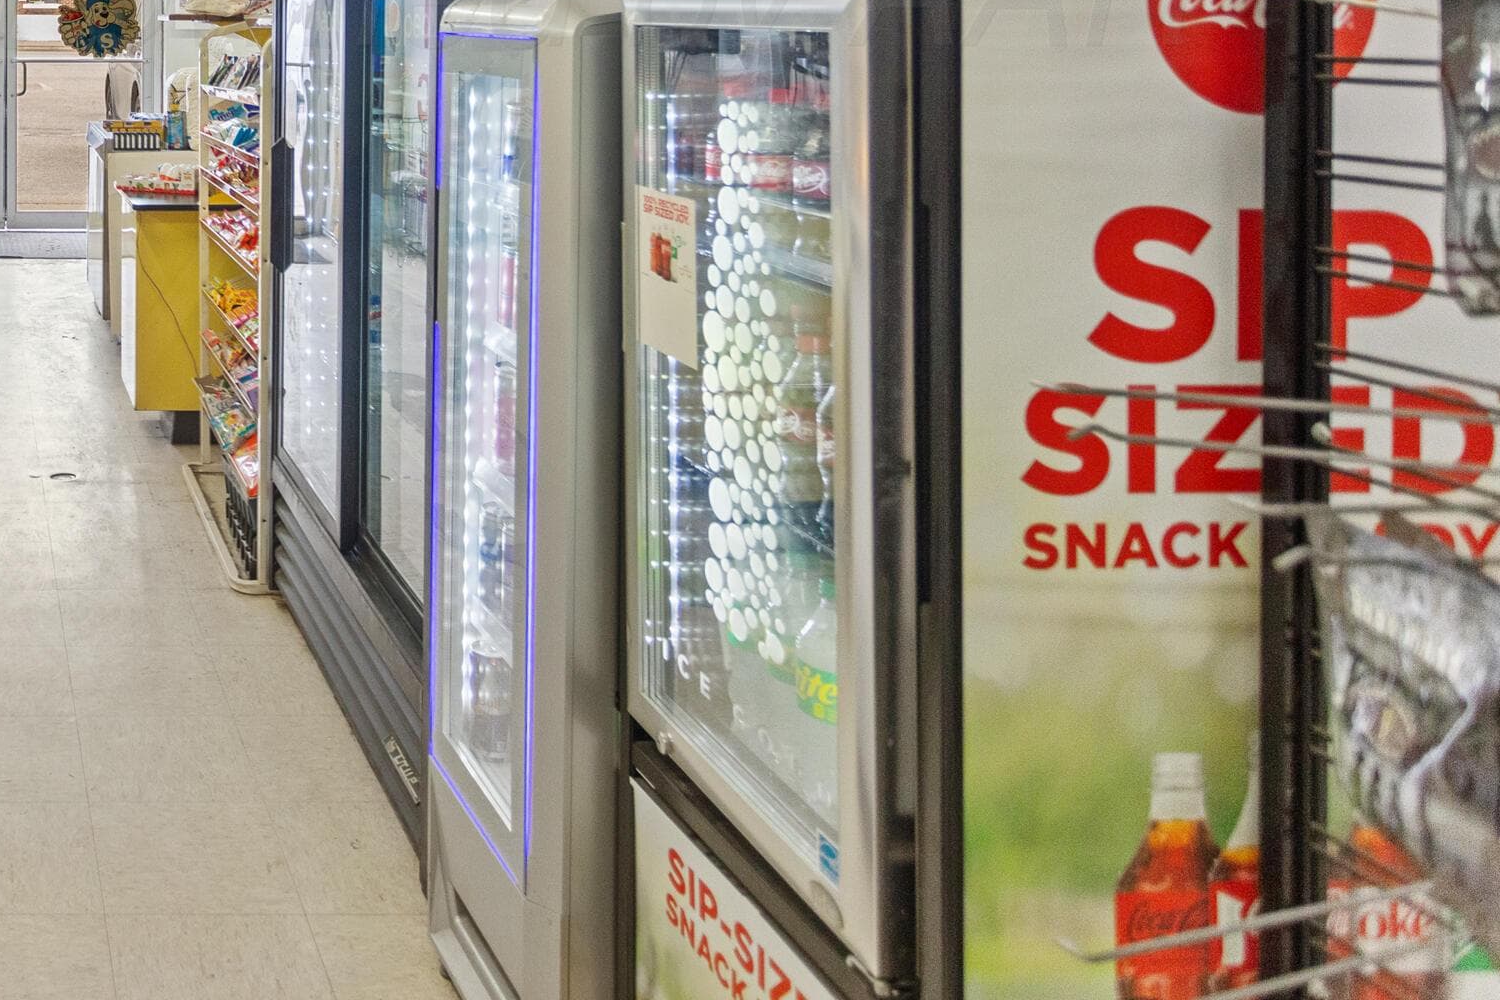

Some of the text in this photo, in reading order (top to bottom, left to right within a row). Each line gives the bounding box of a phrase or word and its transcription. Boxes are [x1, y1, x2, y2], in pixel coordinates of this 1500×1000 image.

[1020, 382, 1496, 497] SIZED
[1021, 522, 1250, 570] SNACK
[665, 892, 747, 1000] SNACK
[667, 847, 810, 1000] SIP-SIZ
